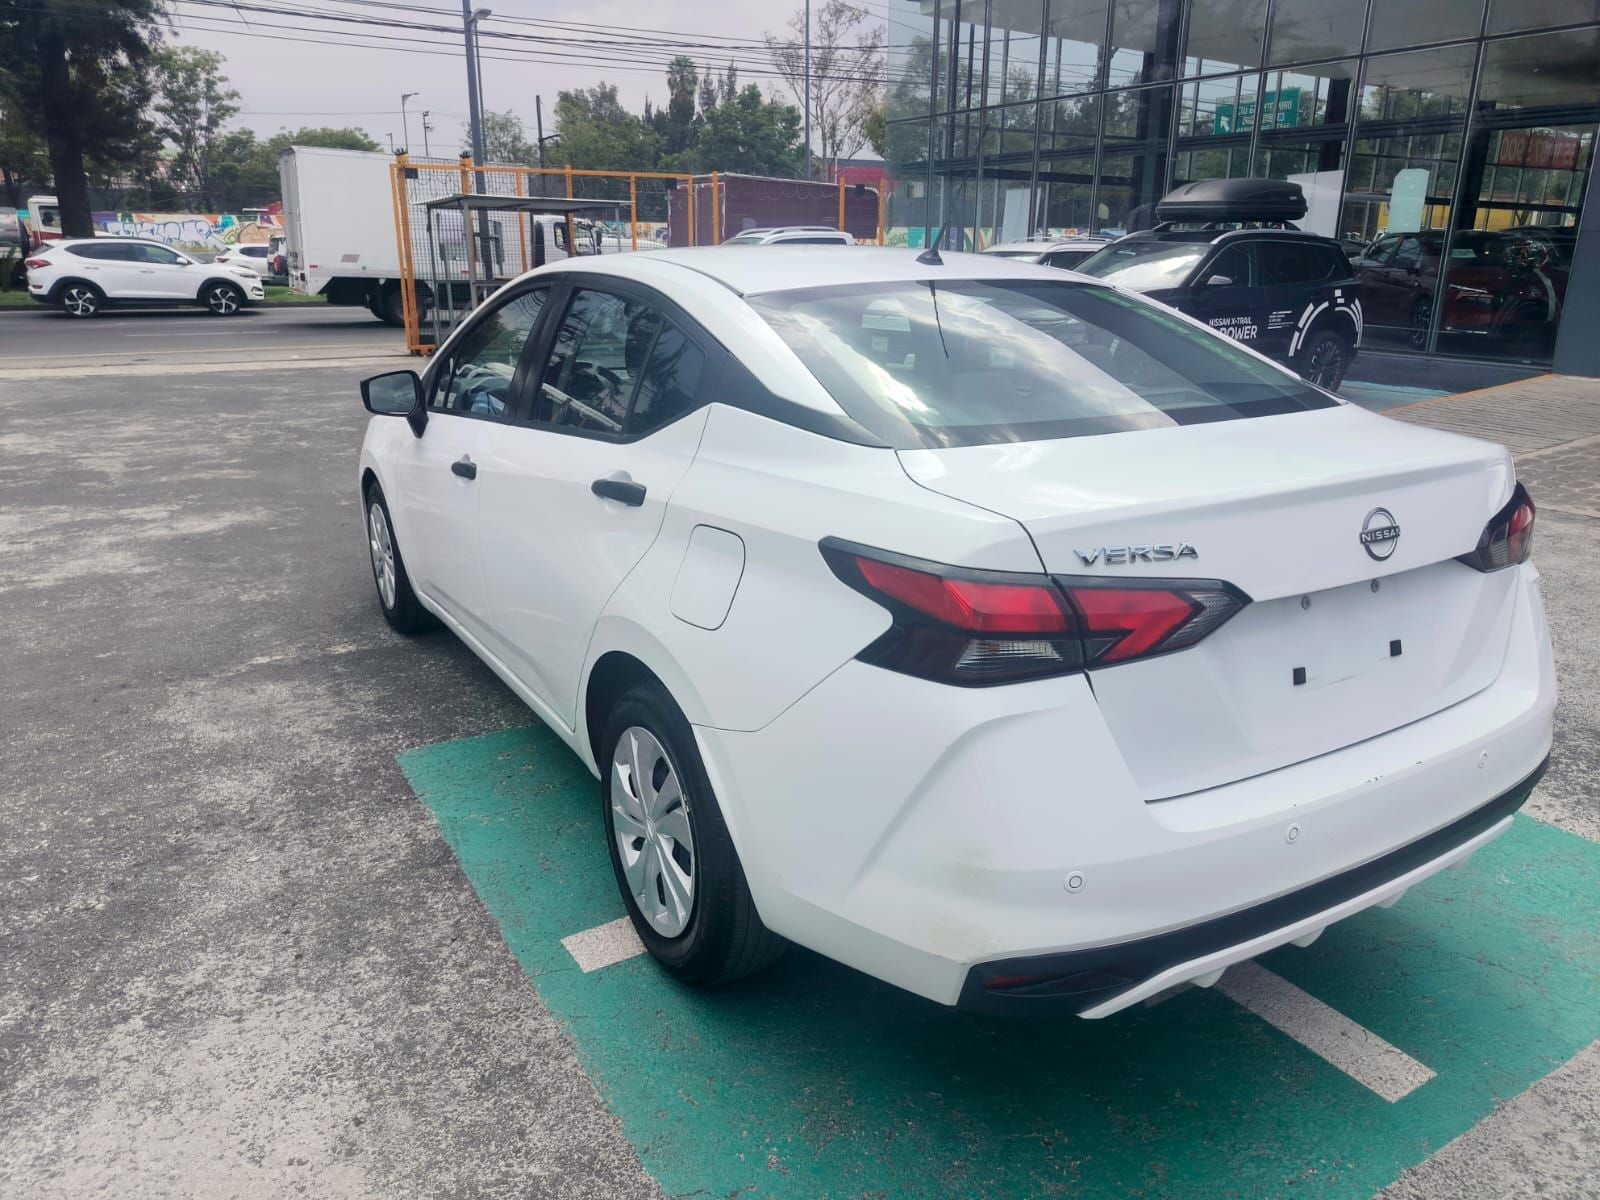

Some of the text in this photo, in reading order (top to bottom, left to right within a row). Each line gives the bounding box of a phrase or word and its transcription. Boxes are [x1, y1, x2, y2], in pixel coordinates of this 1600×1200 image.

[1209, 316, 1252, 327] NISSAN X-TRAIL
[1073, 543, 1198, 567] VERSA
